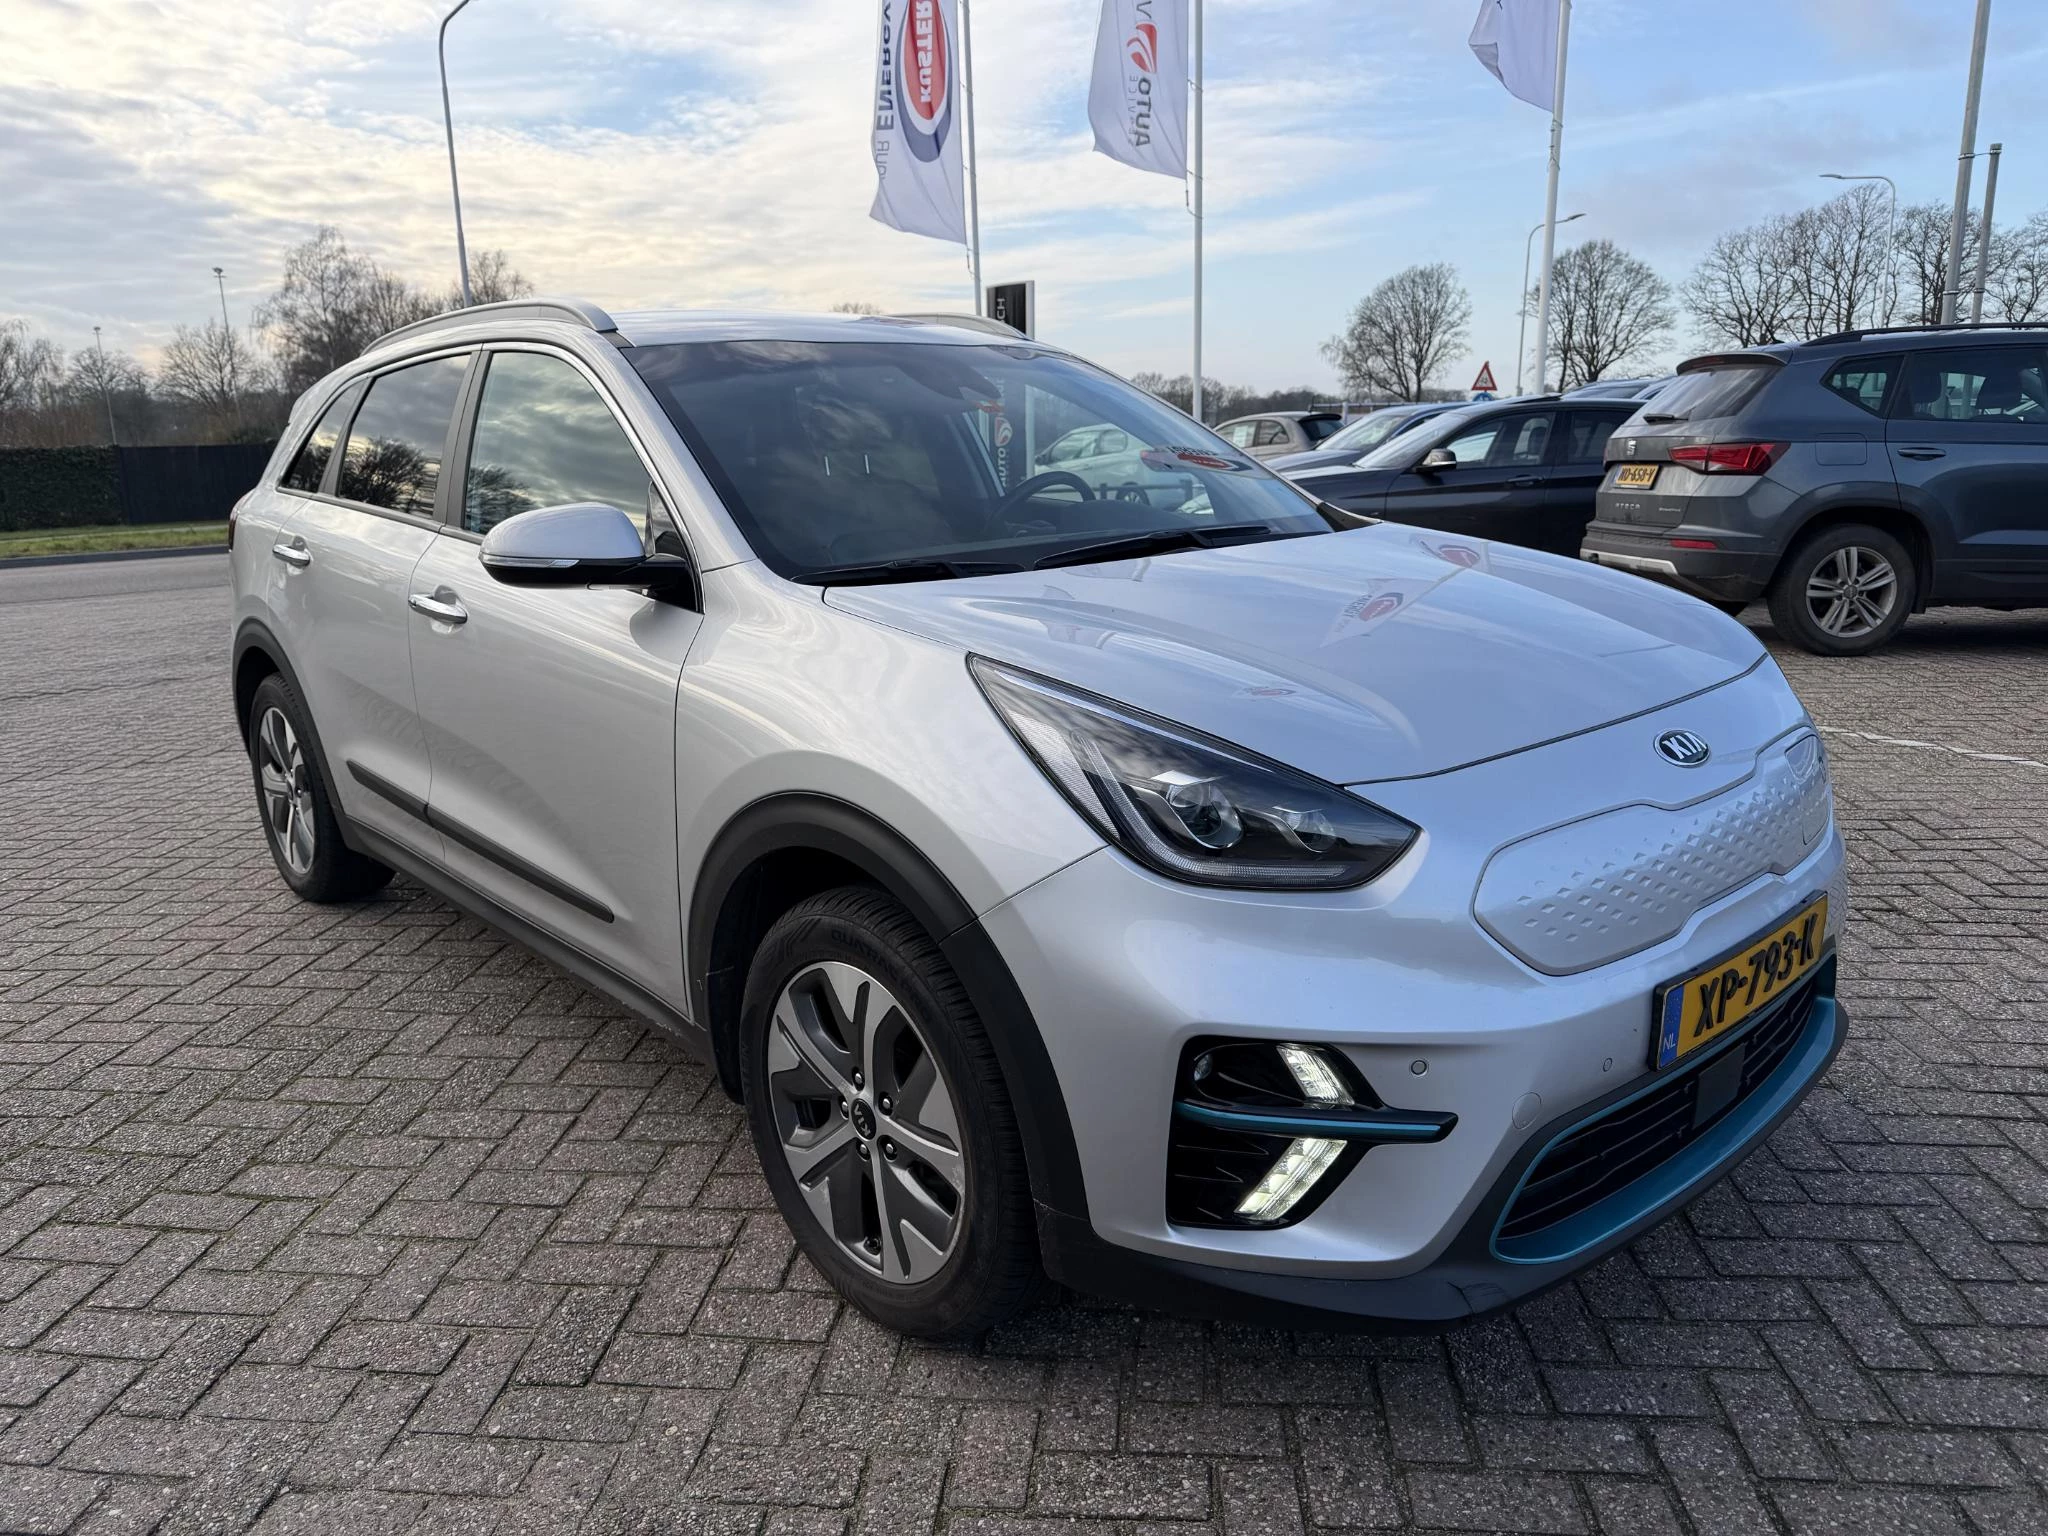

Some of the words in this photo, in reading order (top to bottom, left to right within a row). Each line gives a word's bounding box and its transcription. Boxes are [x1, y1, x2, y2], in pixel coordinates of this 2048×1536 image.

[1661, 732, 1707, 760] KIA
[1693, 912, 1819, 1038] XP-793-K
[1663, 1033, 1677, 1050] NL
